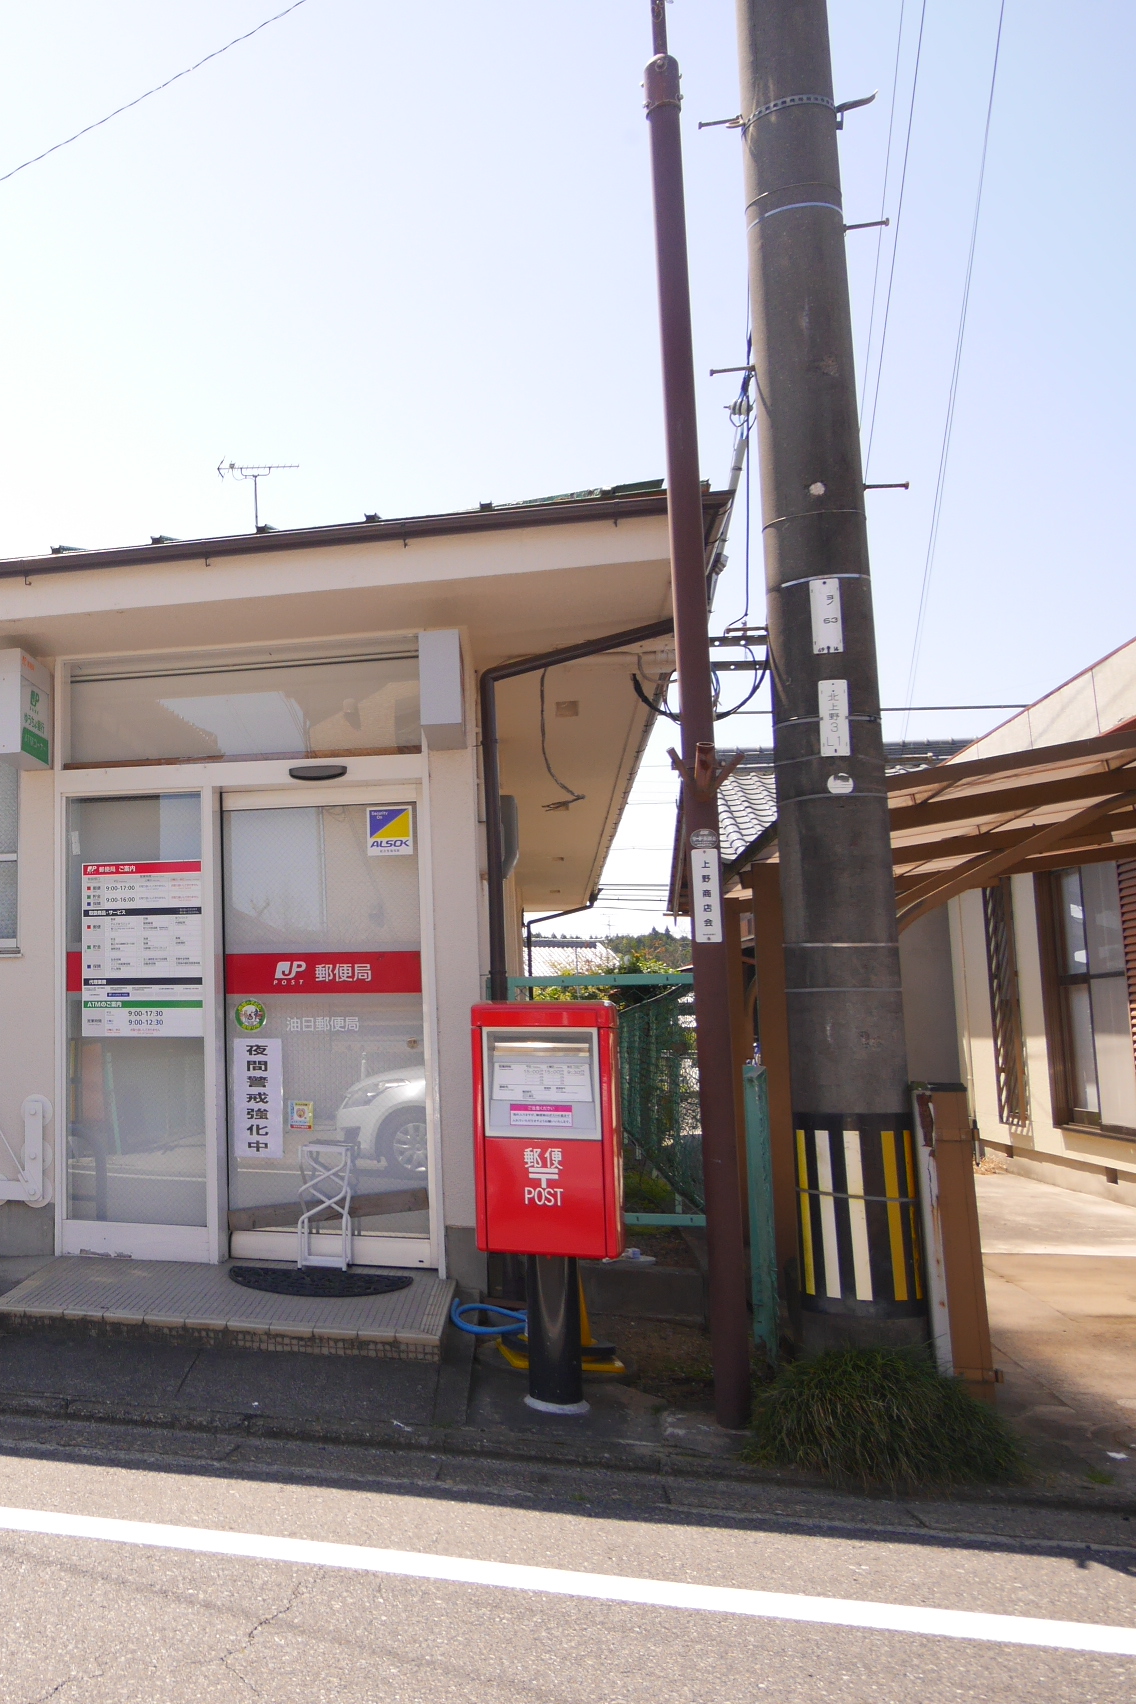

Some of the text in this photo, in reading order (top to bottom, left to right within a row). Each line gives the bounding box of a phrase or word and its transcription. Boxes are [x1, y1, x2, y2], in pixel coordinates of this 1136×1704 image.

[24, 713, 45, 734] ゆうちょ銀行
[370, 839, 410, 848] ALSOK
[105, 884, 136, 892] 9:00-17:00
[701, 860, 713, 927] 上野商店会
[314, 963, 372, 983] 郵便局
[286, 1016, 359, 1032] 油日郵便局
[245, 1044, 269, 1152] 夜間警戒強化中
[524, 1147, 563, 1170] 郵便
[524, 1186, 564, 1206] POST
